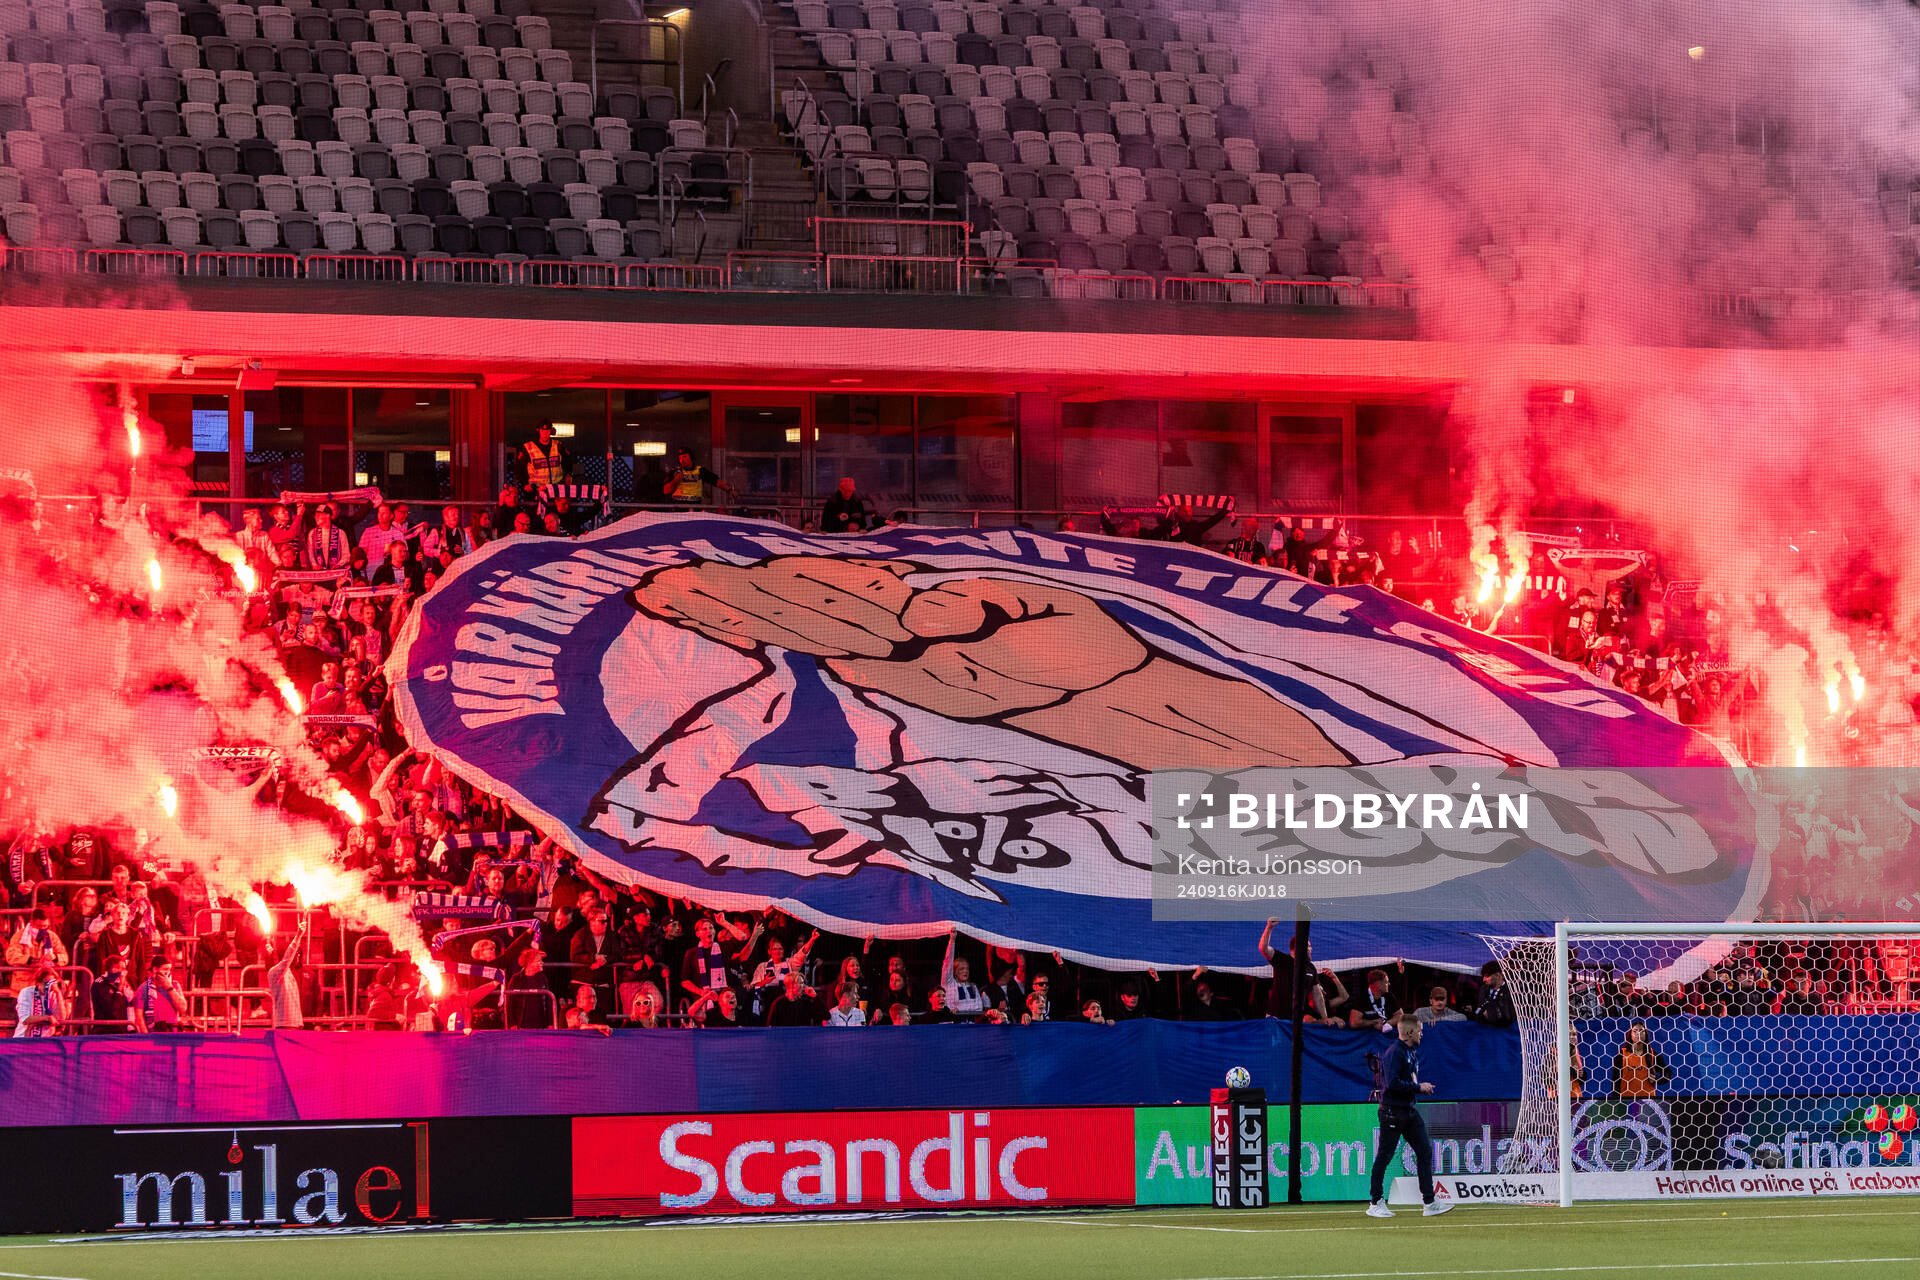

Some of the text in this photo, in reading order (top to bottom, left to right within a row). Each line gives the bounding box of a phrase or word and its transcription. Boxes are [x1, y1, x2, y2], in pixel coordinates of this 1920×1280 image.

[423, 622, 566, 729] VÅR
[114, 1121, 437, 1228] milael
[659, 1112, 1048, 1208] Scandic
[1213, 1104, 1231, 1207] SELECT
[1238, 1104, 1263, 1207] SELECT
[1455, 1179, 1545, 1199] Bomben
[1656, 1174, 1737, 1195] Handla
[1741, 1173, 1805, 1193] online
[1810, 1171, 1839, 1195] på
